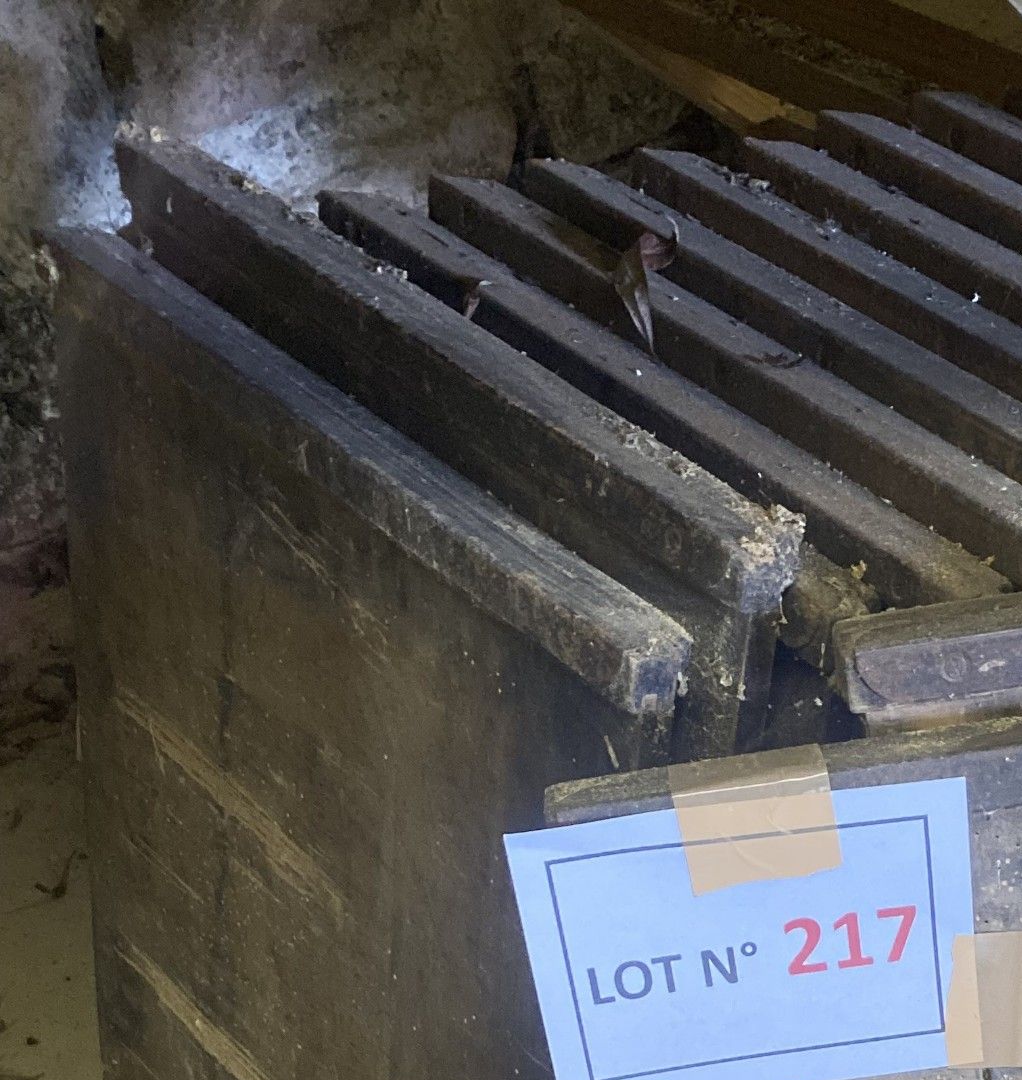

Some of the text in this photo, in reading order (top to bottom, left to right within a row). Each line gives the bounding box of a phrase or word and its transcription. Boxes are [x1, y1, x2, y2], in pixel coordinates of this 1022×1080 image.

[587, 905, 917, 1005] LOT N° 217
